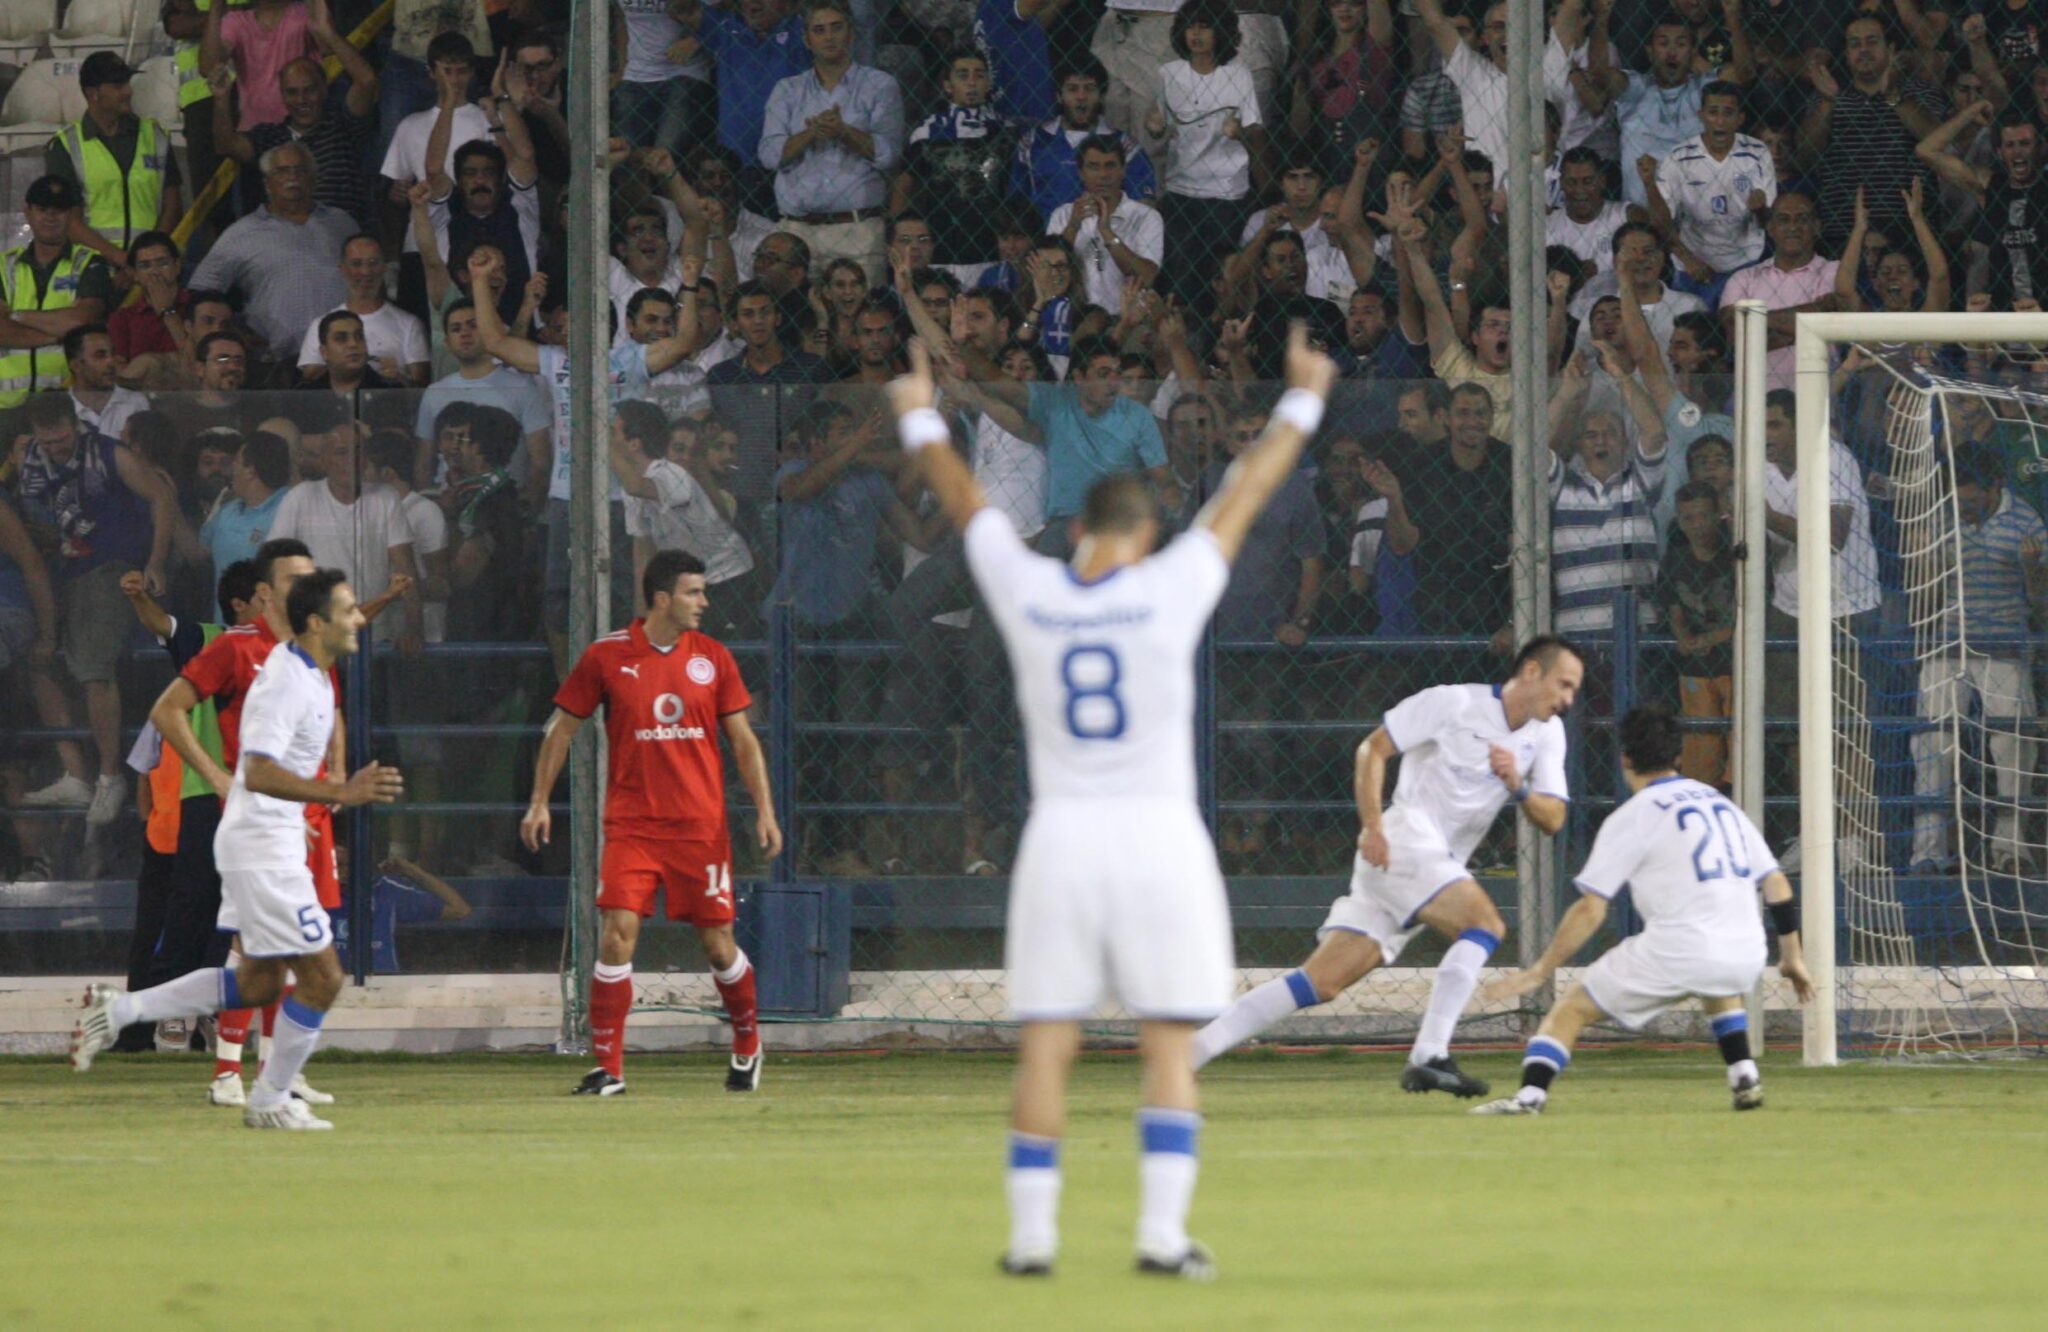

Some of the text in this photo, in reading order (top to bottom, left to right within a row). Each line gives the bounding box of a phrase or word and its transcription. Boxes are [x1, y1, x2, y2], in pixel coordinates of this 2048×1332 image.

[1062, 644, 1126, 739] 8
[634, 723, 705, 741] vodafone
[1677, 804, 1751, 881] 20
[704, 861, 731, 897] 14
[297, 904, 324, 942] 5
